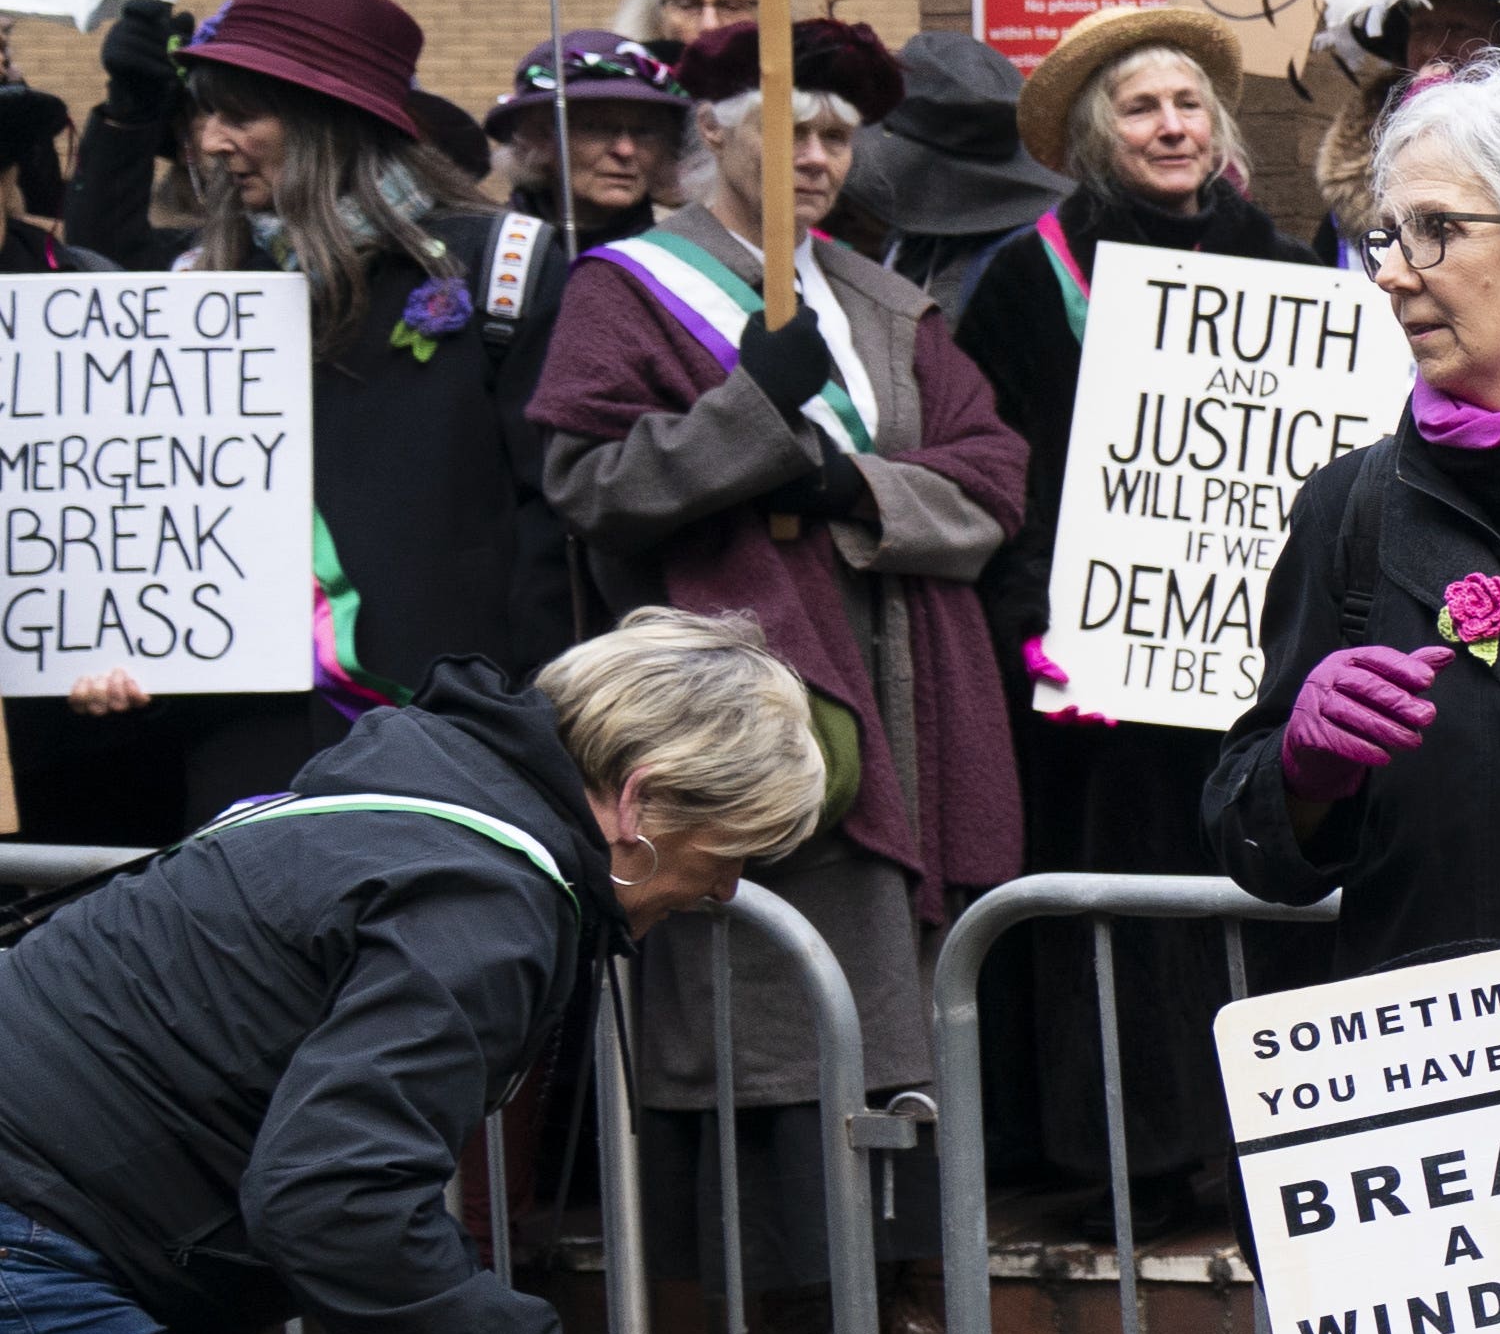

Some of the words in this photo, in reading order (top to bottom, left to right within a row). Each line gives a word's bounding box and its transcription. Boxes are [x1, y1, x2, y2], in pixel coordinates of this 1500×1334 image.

[0, 290, 16, 340] N
[43, 286, 170, 340] CASE
[194, 290, 265, 339] OF
[1146, 279, 1363, 373] TRUTH
[0, 347, 284, 419] LIMATE
[1205, 367, 1279, 398] AND
[0, 432, 286, 505] MERGENCY
[1108, 391, 1369, 482] JUSTICE
[1102, 466, 1192, 522] WILL
[1201, 477, 1300, 535] PREV
[7, 504, 245, 579] BREAK
[1185, 531, 1216, 564] IF
[1222, 534, 1276, 572] WE
[3, 584, 236, 671] GLASS
[1079, 559, 1262, 649] DEMA
[1123, 643, 1164, 689] IT
[1171, 648, 1223, 696] BE
[1258, 1075, 1358, 1117] YOU
[1444, 1225, 1484, 1267] A
